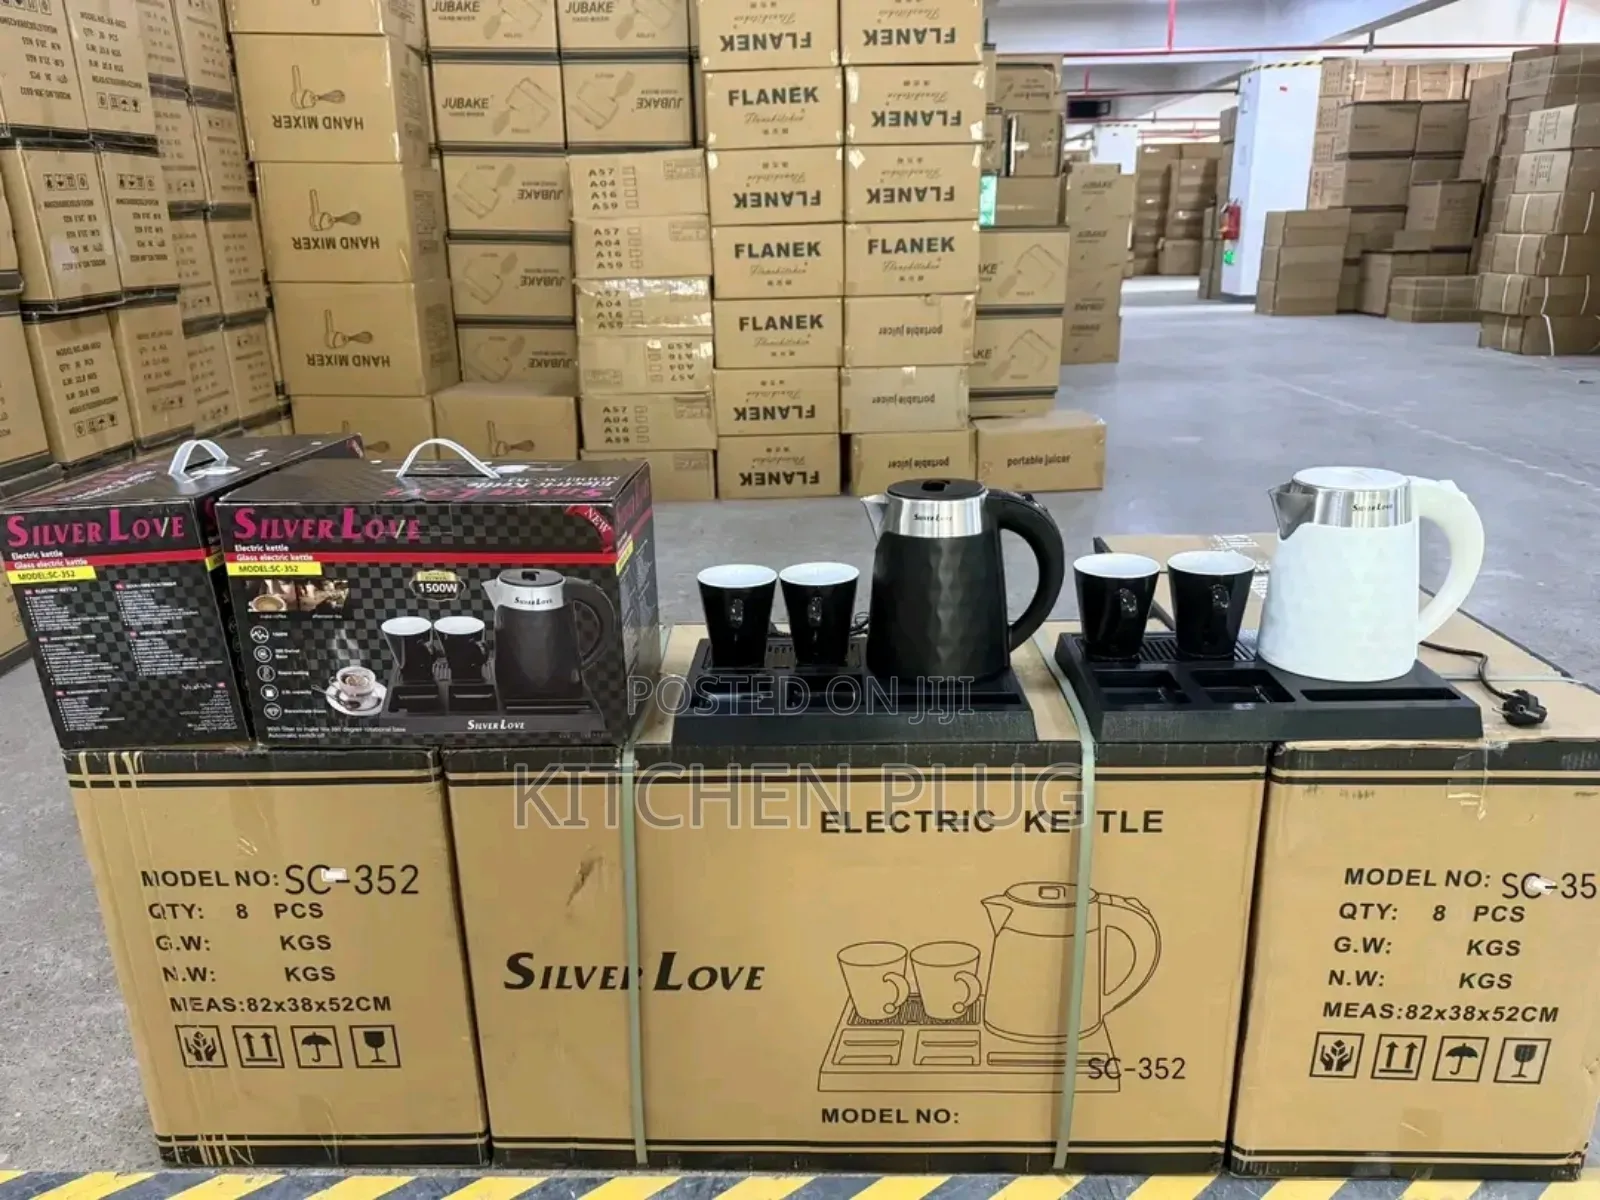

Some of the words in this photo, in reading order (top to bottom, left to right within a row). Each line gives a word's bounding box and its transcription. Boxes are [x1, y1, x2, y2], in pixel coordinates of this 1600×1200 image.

[432, 0, 480, 12] JUBAKE
[564, 0, 615, 14] JUBAKE
[719, 31, 813, 52] FLANEK
[862, 27, 956, 46] FLANEK
[442, 97, 489, 109] JUBAKE
[635, 97, 684, 110] JUBAKE
[727, 86, 820, 107] FLANEK
[272, 115, 319, 130] MIXER
[322, 116, 364, 130] HAND
[871, 110, 962, 128] FLANEK
[517, 188, 564, 200] JUBAKE
[733, 190, 822, 208] FLANEK
[866, 185, 956, 204] FLANEK
[291, 236, 337, 250] MIXER
[340, 236, 380, 249] HAND
[867, 235, 956, 255] FLANEK
[734, 241, 822, 260] FLANEK
[519, 274, 566, 287] JUBAKE
[738, 313, 824, 332] FLANEK
[878, 324, 904, 336] juicer
[905, 324, 943, 336] portable
[305, 353, 350, 367] MIXER
[351, 354, 390, 367] HAND
[528, 357, 574, 369] JUBAKE
[871, 393, 897, 405] juicer
[898, 392, 936, 405] portable
[734, 404, 816, 421] FLANEK
[888, 458, 912, 470] juicer
[913, 455, 950, 470] portable
[1006, 455, 1043, 468] portable
[1044, 453, 1071, 466] juicer
[739, 470, 820, 486] FLANEK
[6, 515, 103, 547] SILVER
[109, 509, 185, 541] LOVE
[233, 507, 334, 540] SILVER
[341, 507, 421, 541] LOVE
[584, 508, 613, 533] NEW
[11, 550, 40, 560] Electric
[40, 549, 63, 558] kettle
[235, 544, 264, 552] Electric
[265, 543, 289, 552] kettle
[14, 561, 35, 570] Glass
[37, 559, 65, 568] electric
[66, 557, 88, 567] kettle
[236, 553, 258, 562] Glass
[259, 553, 288, 562] electric
[289, 553, 313, 561] kettle
[17, 570, 76, 580] MODEL:SC-352
[238, 564, 299, 573] MODEL:SC-352
[418, 583, 458, 594] 1500W
[467, 719, 499, 730] SILVER
[500, 719, 525, 730] LOVE
[820, 810, 995, 834] ELECTRIC
[1024, 810, 1164, 834] KETLE
[141, 870, 230, 887] MODEL
[235, 870, 280, 887] NO:
[285, 864, 419, 896] SC-352
[1344, 867, 1437, 887] MODEL
[1445, 870, 1491, 887] NO:
[148, 902, 204, 920] QTY:
[236, 903, 249, 919] 8
[274, 902, 324, 919] PCS
[1339, 902, 1398, 920] QTY:
[1432, 905, 1446, 921] 8
[1473, 905, 1526, 922] PCS
[156, 935, 211, 951] G.W:
[279, 934, 332, 950] KGS
[1333, 936, 1392, 954] G.W:
[1466, 939, 1521, 956] KGS
[162, 966, 216, 982] N.W:
[284, 966, 336, 982] KGS
[653, 951, 766, 991] LOVE
[1328, 969, 1385, 987] N.W:
[1458, 973, 1513, 989] KGS
[170, 996, 392, 1012] MEAS:82x38x52CM
[1322, 1001, 1560, 1023] MEAS:82x38x52CM
[1087, 1056, 1187, 1080] SC-352
[821, 1107, 909, 1124] MODEL
[915, 1107, 961, 1124] NO:
